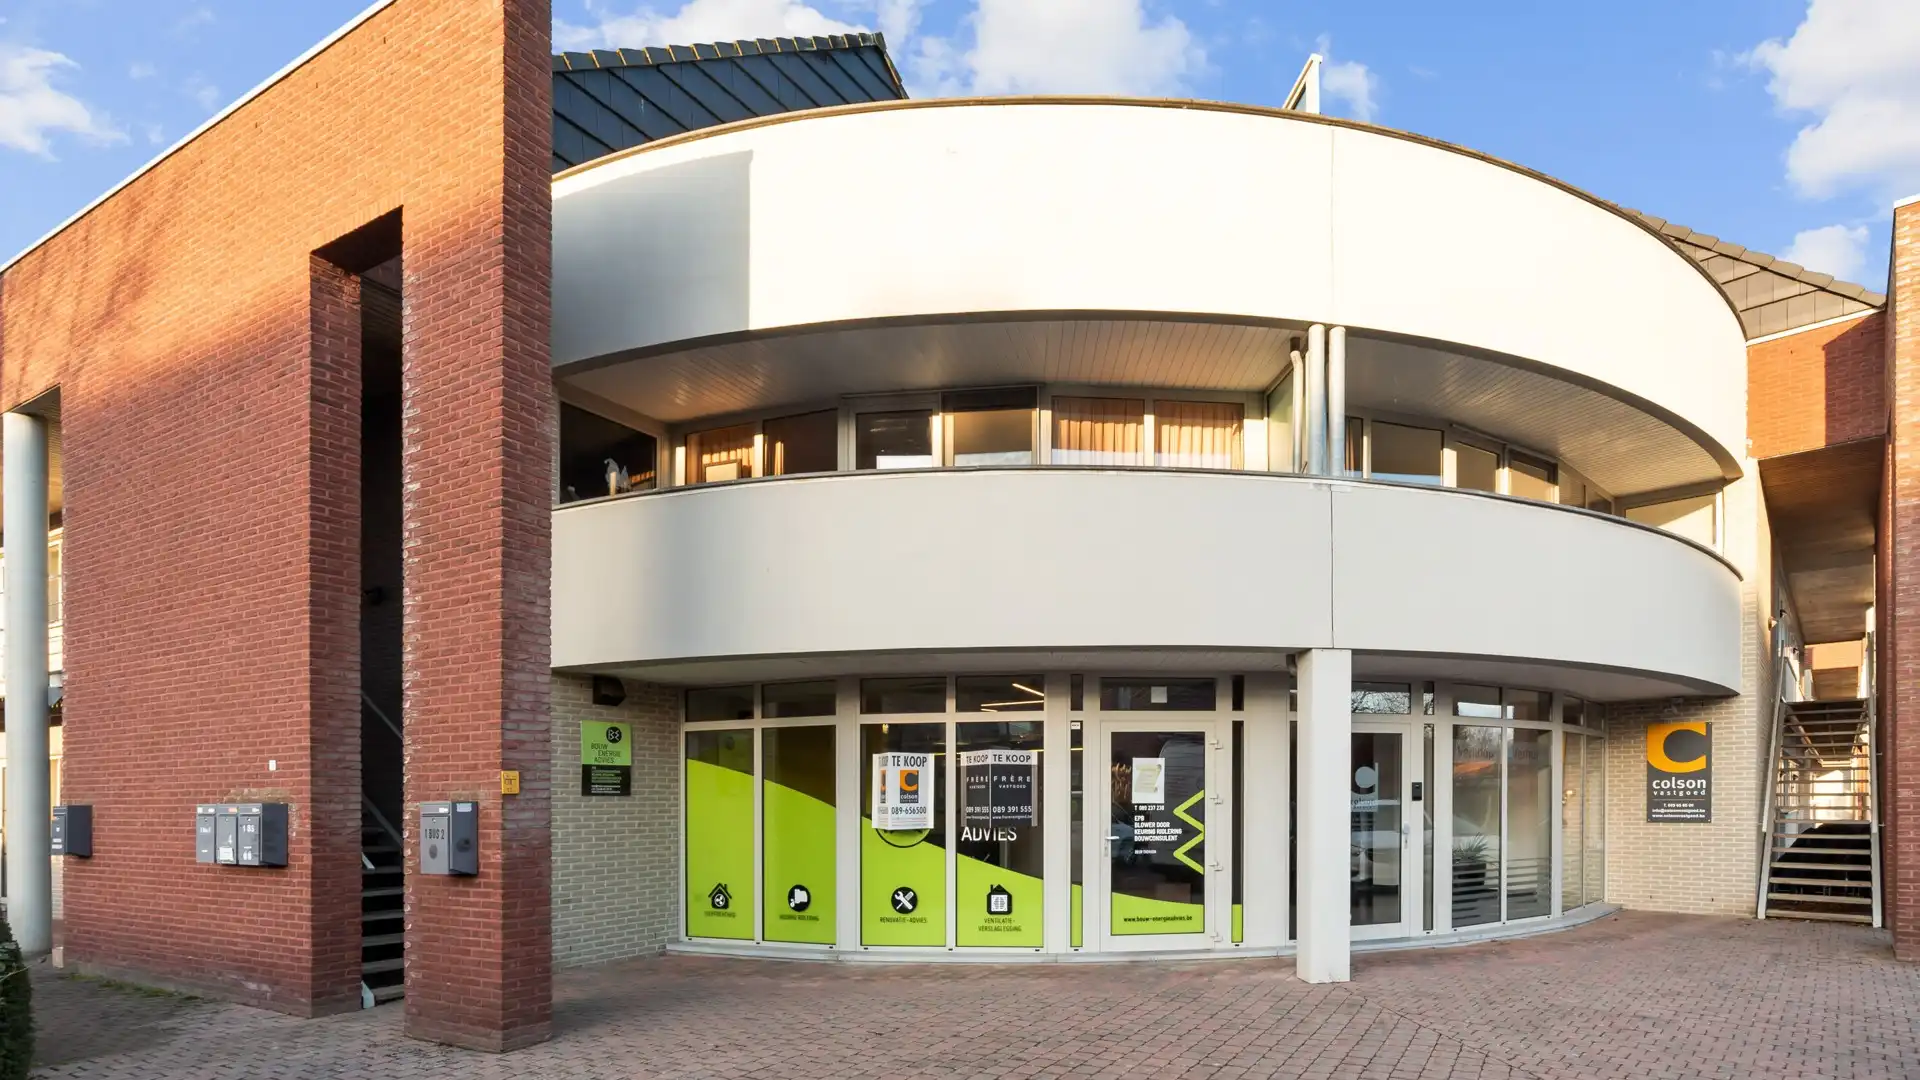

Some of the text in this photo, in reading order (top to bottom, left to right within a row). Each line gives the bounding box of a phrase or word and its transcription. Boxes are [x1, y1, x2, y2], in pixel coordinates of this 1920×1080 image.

[892, 756, 900, 766] TE
[904, 756, 927, 767] KOOP
[966, 754, 989, 763] TE KOOP
[993, 754, 1003, 762] TE
[1652, 777, 1707, 789] colson
[891, 806, 927, 814] 089-656500
[429, 829, 440, 841] BUS
[441, 829, 445, 840] 2
